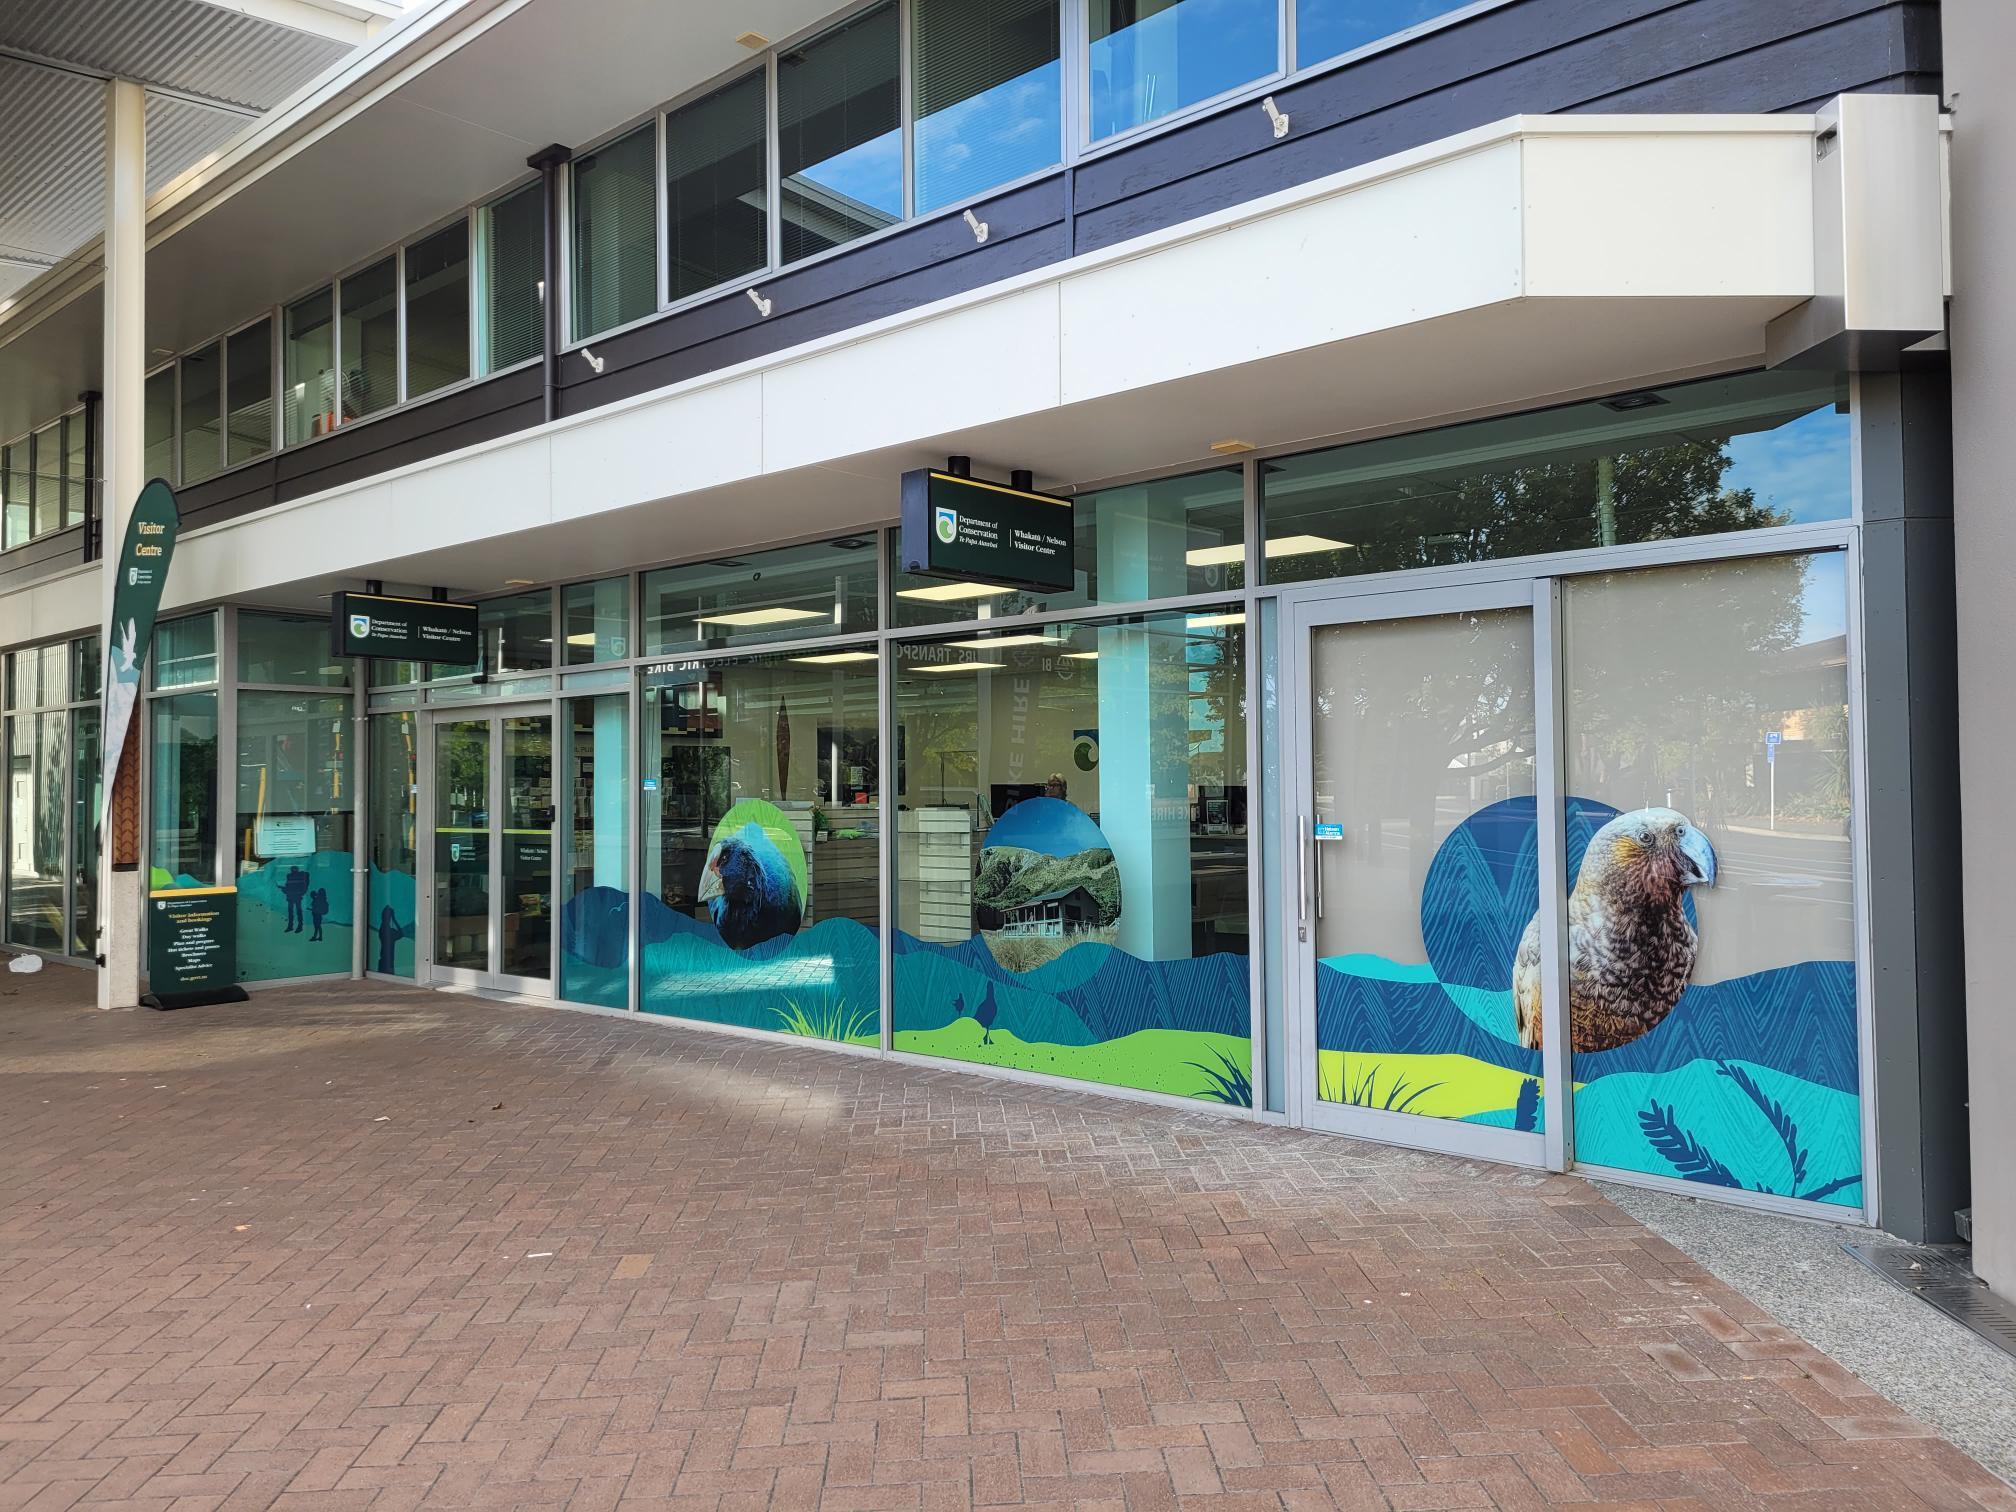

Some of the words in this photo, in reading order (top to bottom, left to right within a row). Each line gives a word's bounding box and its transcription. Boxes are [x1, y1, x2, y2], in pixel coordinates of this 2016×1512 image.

[138, 521, 165, 534] Visitor
[959, 515, 991, 528] Department
[992, 521, 998, 529] of
[958, 525, 998, 540] Conservation
[965, 537, 978, 546] Papa
[1014, 540, 1035, 552] Visitor
[1036, 545, 1056, 555] Centre
[1046, 536, 1067, 546] Nelson
[135, 543, 162, 556] Centre
[371, 618, 401, 627] Department
[371, 625, 408, 634] Conservation
